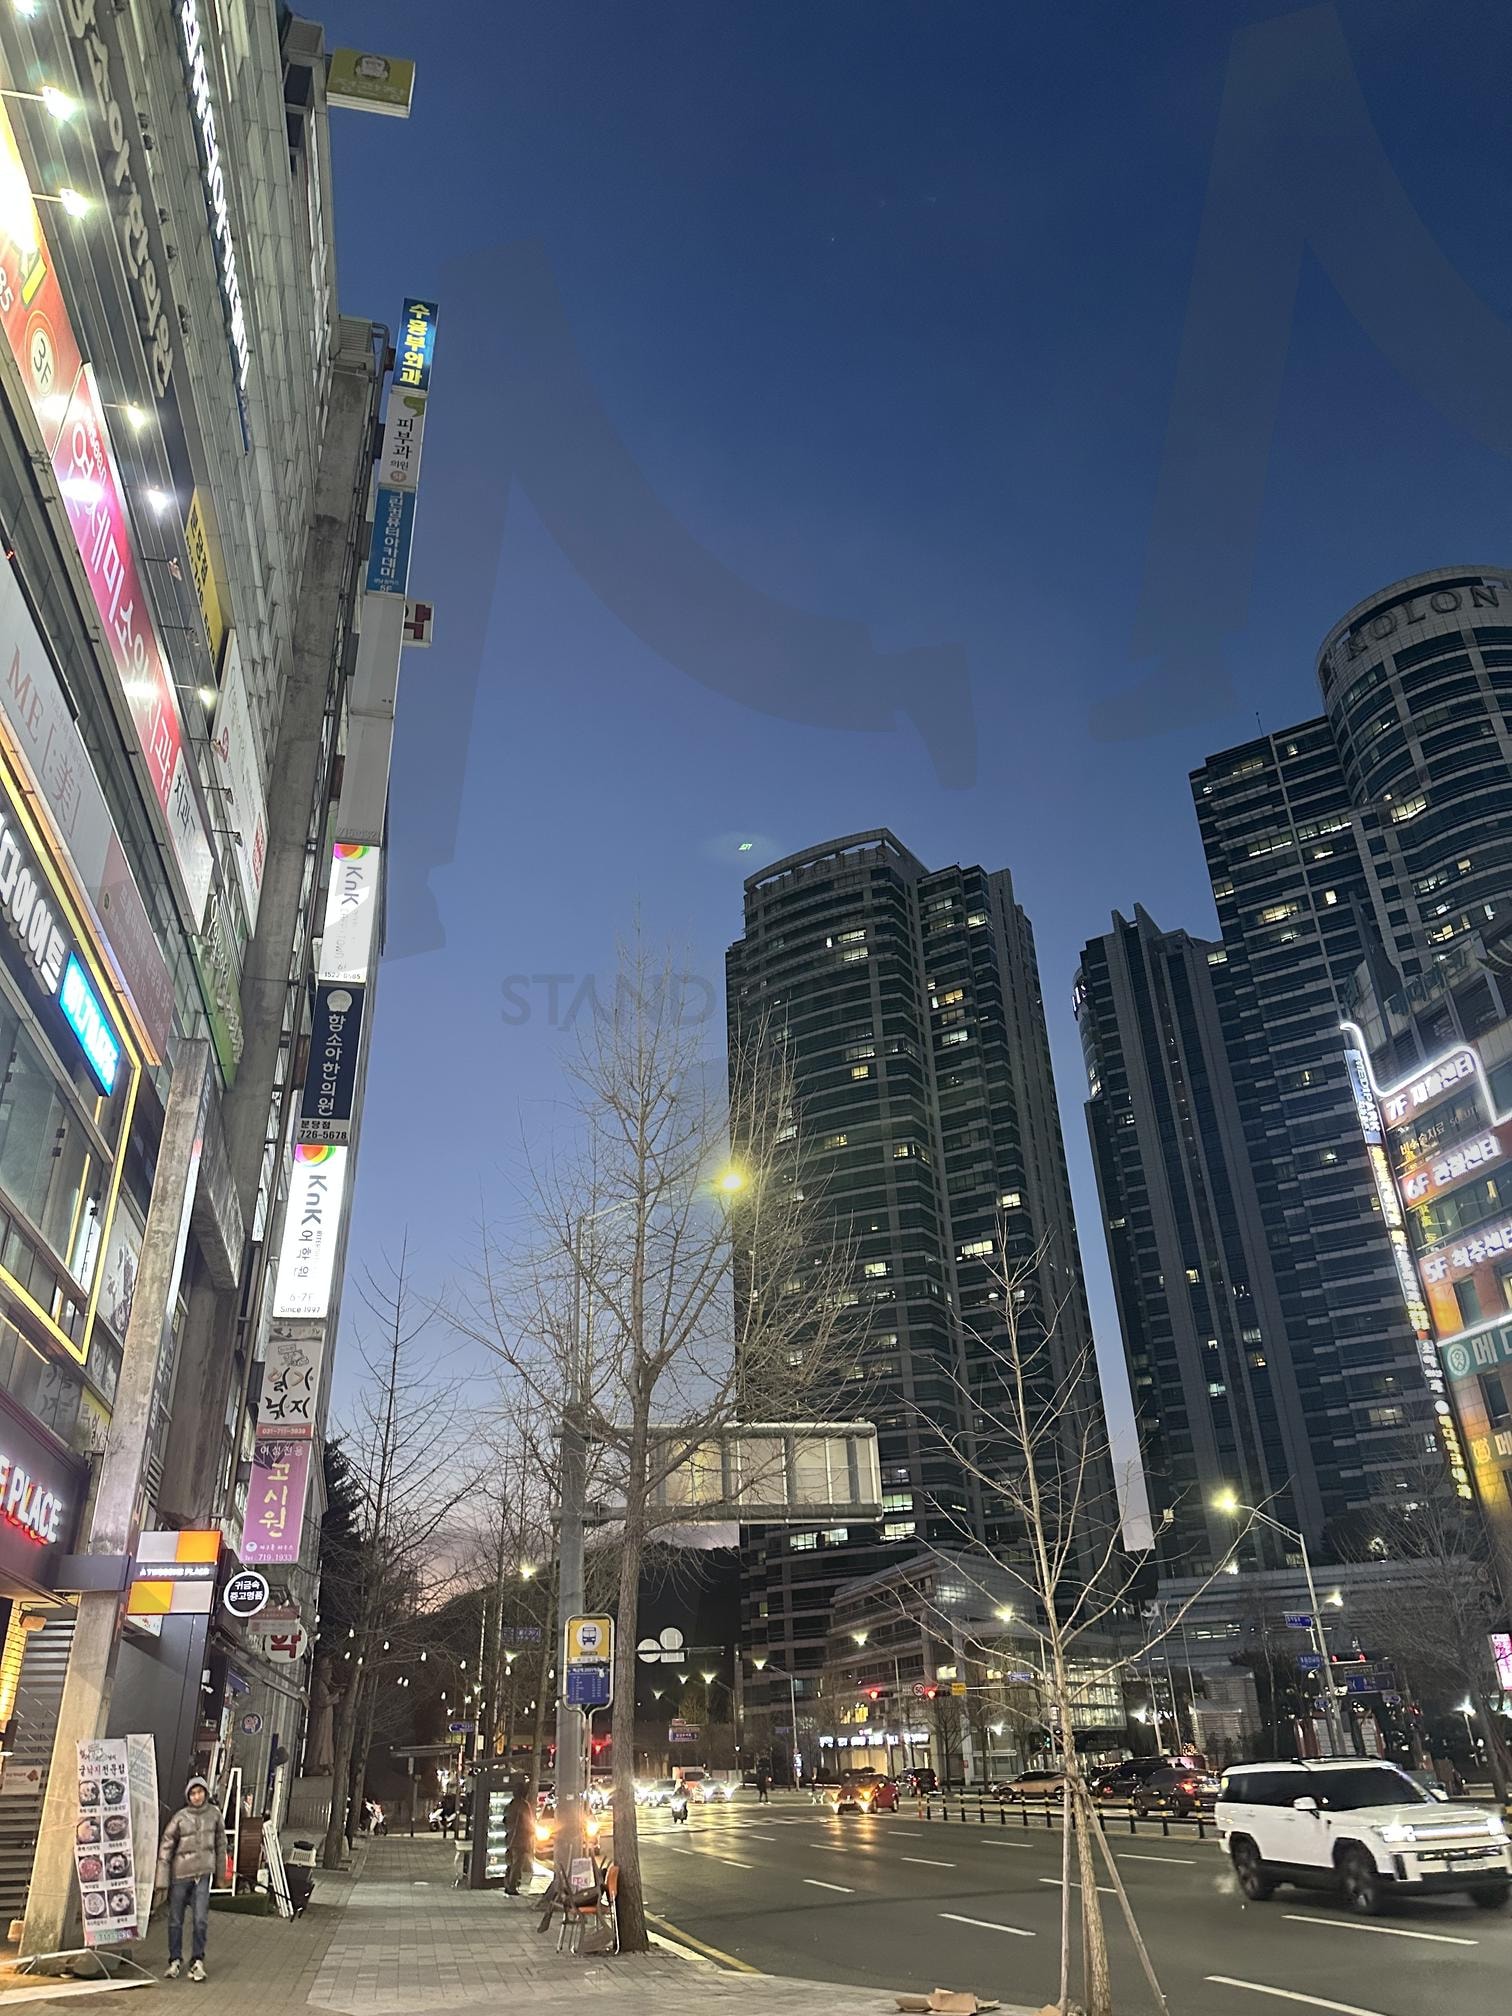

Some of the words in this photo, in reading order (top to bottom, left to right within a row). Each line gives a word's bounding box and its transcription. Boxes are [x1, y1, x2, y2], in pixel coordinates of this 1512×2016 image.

[393, 418, 413, 459] 피부과
[1342, 585, 1500, 662] KOLON
[6, 641, 45, 745] ME
[341, 866, 363, 906] KnK
[317, 1014, 347, 1117] 함소아한의원
[301, 1120, 331, 1129] 분당점
[1386, 1093, 1408, 1121] 7F
[300, 1129, 347, 1140] 726-5678
[301, 1175, 328, 1225] KnK
[1407, 1172, 1430, 1199] 6F
[293, 1230, 314, 1278] 어학원
[7, 1466, 62, 1544] PLACE
[258, 1462, 291, 1538] 고시원
[229, 1591, 263, 1602] 중고명품
[234, 1580, 260, 1590] 귀금속
